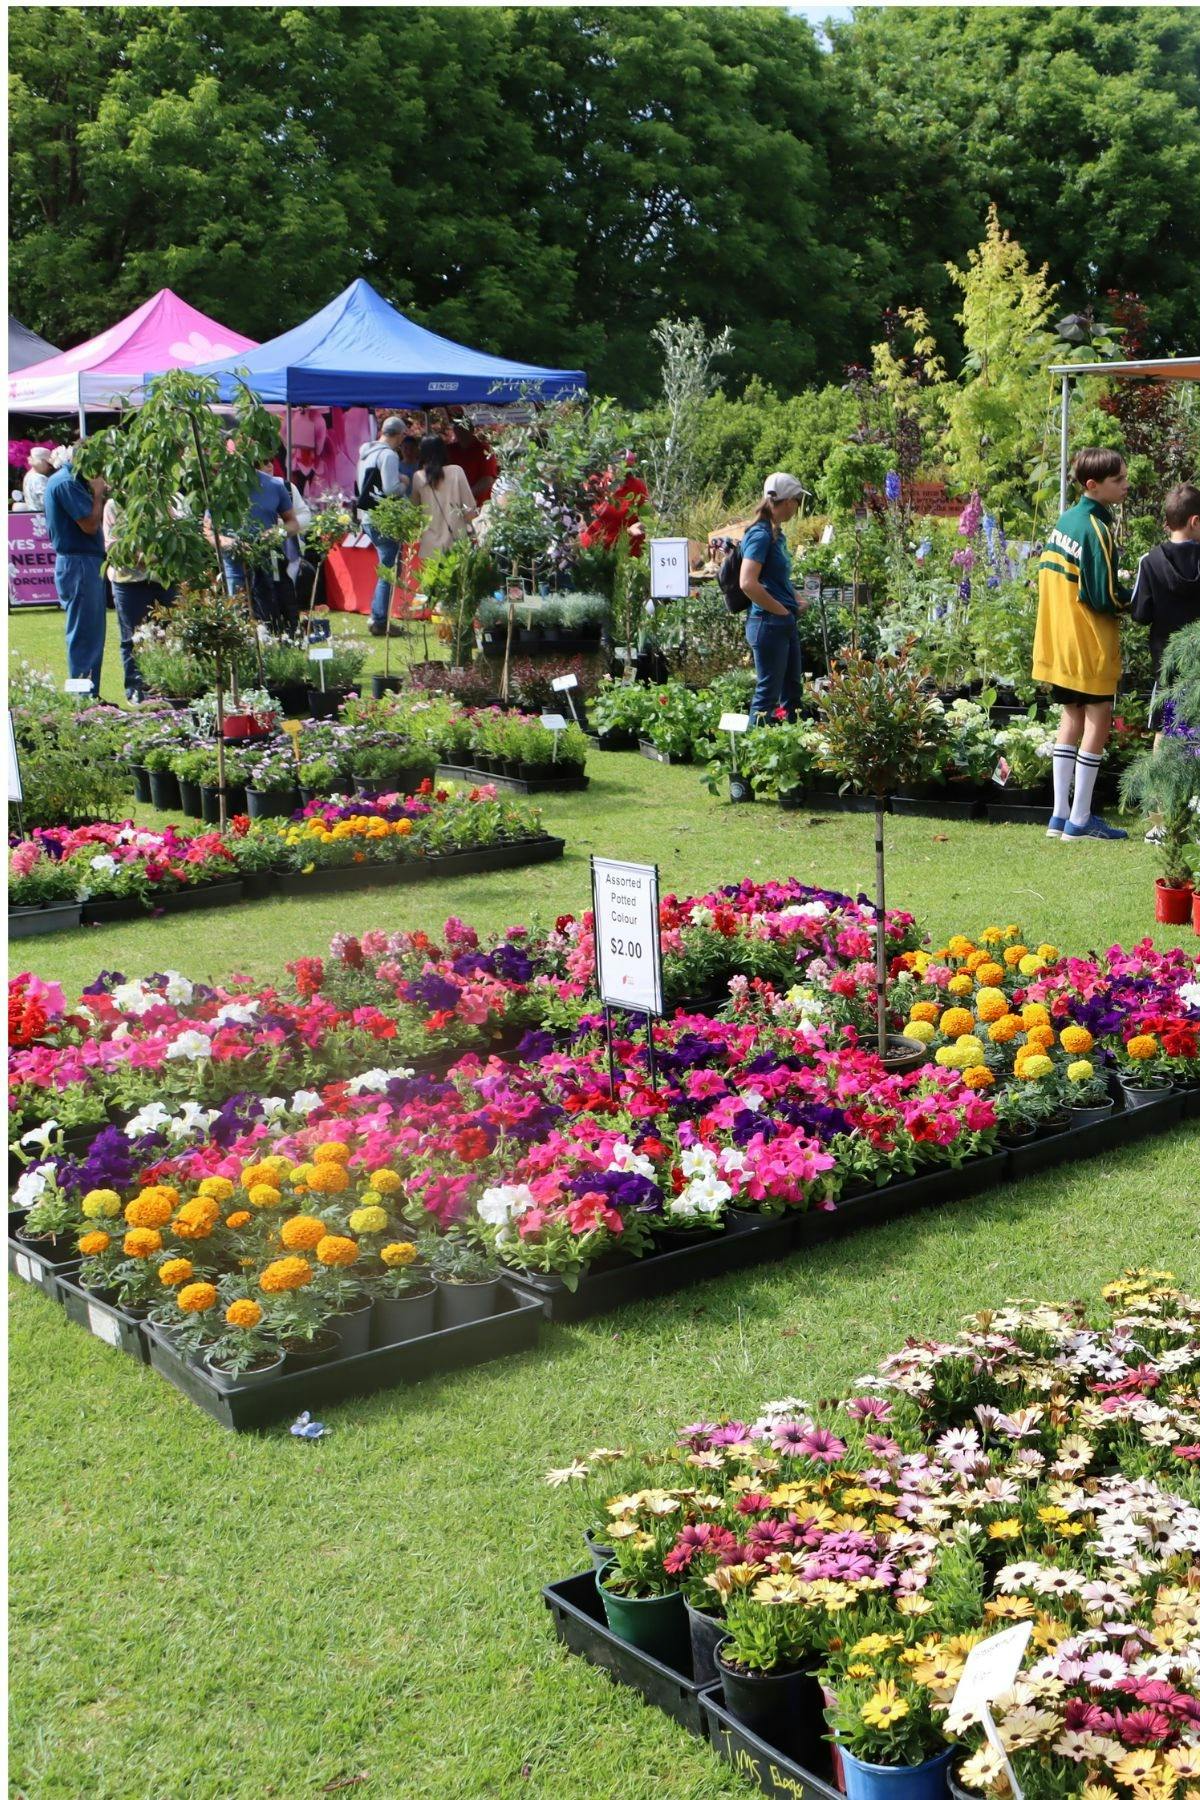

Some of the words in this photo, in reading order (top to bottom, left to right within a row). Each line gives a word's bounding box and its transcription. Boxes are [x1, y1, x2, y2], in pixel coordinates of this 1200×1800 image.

[8, 540, 35, 550] YES
[660, 557, 677, 567] $10
[605, 873, 642, 889] Assorted
[610, 892, 637, 907] Potted
[611, 910, 637, 925] Colour
[610, 937, 642, 958] $2.00
